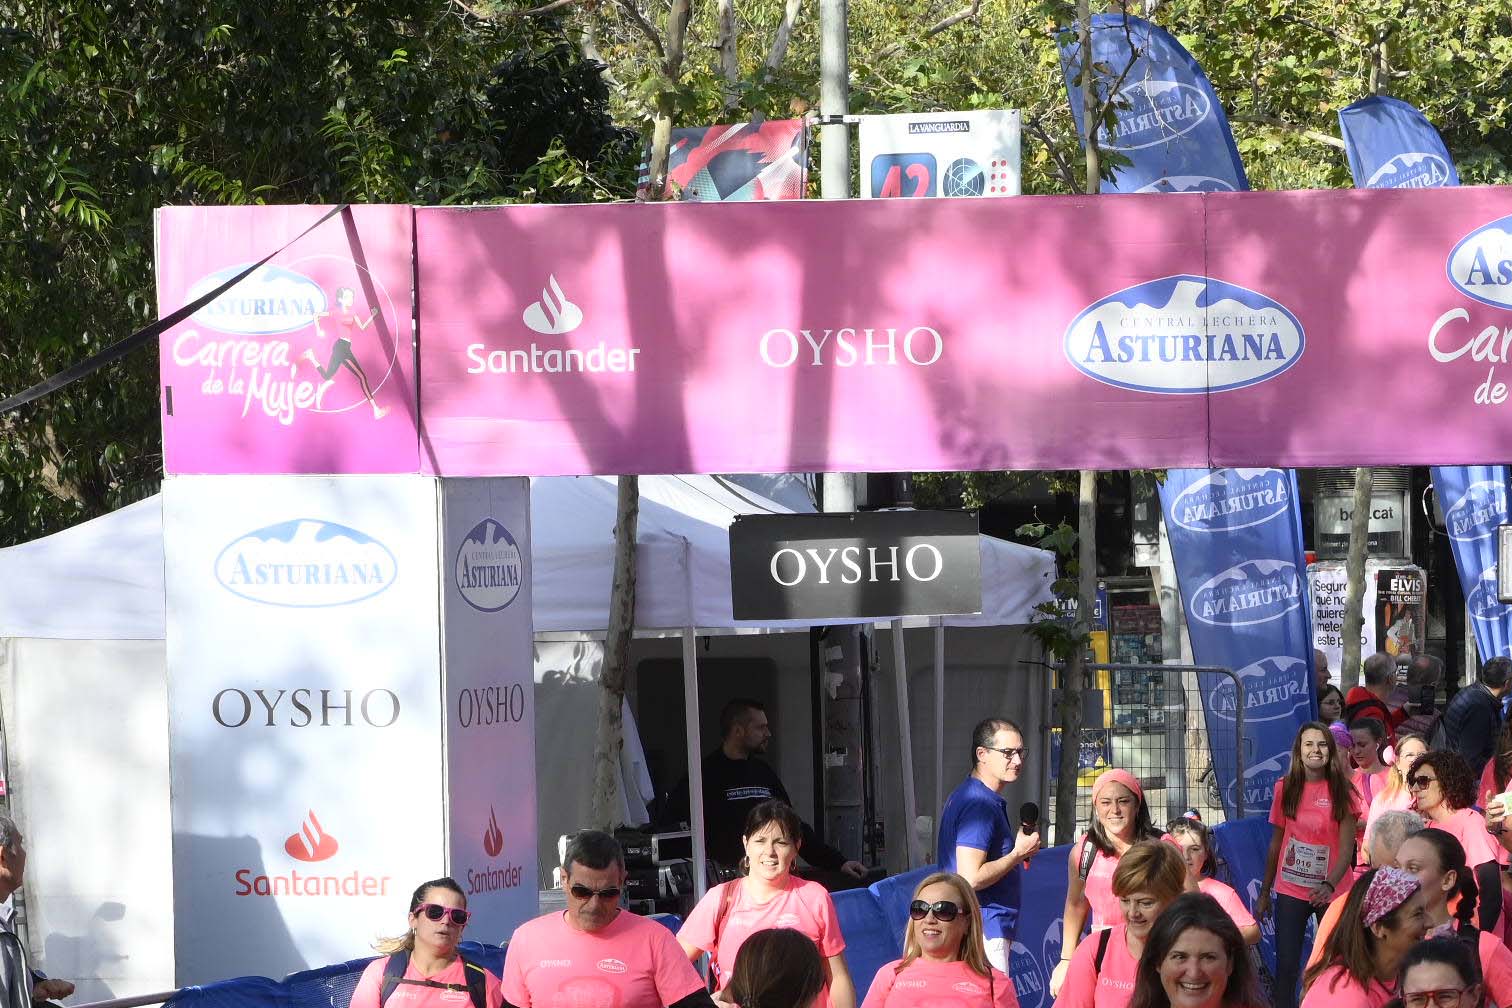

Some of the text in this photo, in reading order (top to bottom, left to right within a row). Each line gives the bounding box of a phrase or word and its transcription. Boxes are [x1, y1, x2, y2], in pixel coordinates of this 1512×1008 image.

[1120, 315, 1278, 328] CENTRAL LECHERA
[173, 330, 289, 366] Carrera
[466, 342, 640, 373] Santander
[760, 326, 943, 367] OYSHO
[1083, 320, 1285, 363] ASTURIANA
[202, 364, 335, 425] de la Mujer
[1475, 371, 1505, 405] de
[230, 552, 384, 585] ASTURIANA
[461, 553, 518, 588] ASTURIANA
[770, 544, 943, 587] OYSHO
[1391, 579, 1420, 591] ELVIS
[1316, 598, 1332, 607] que
[1318, 637, 1335, 645] este
[212, 688, 400, 727] OYSHO
[459, 683, 524, 728] OYSHO
[235, 869, 391, 896] Santander
[467, 862, 521, 895] Santander
